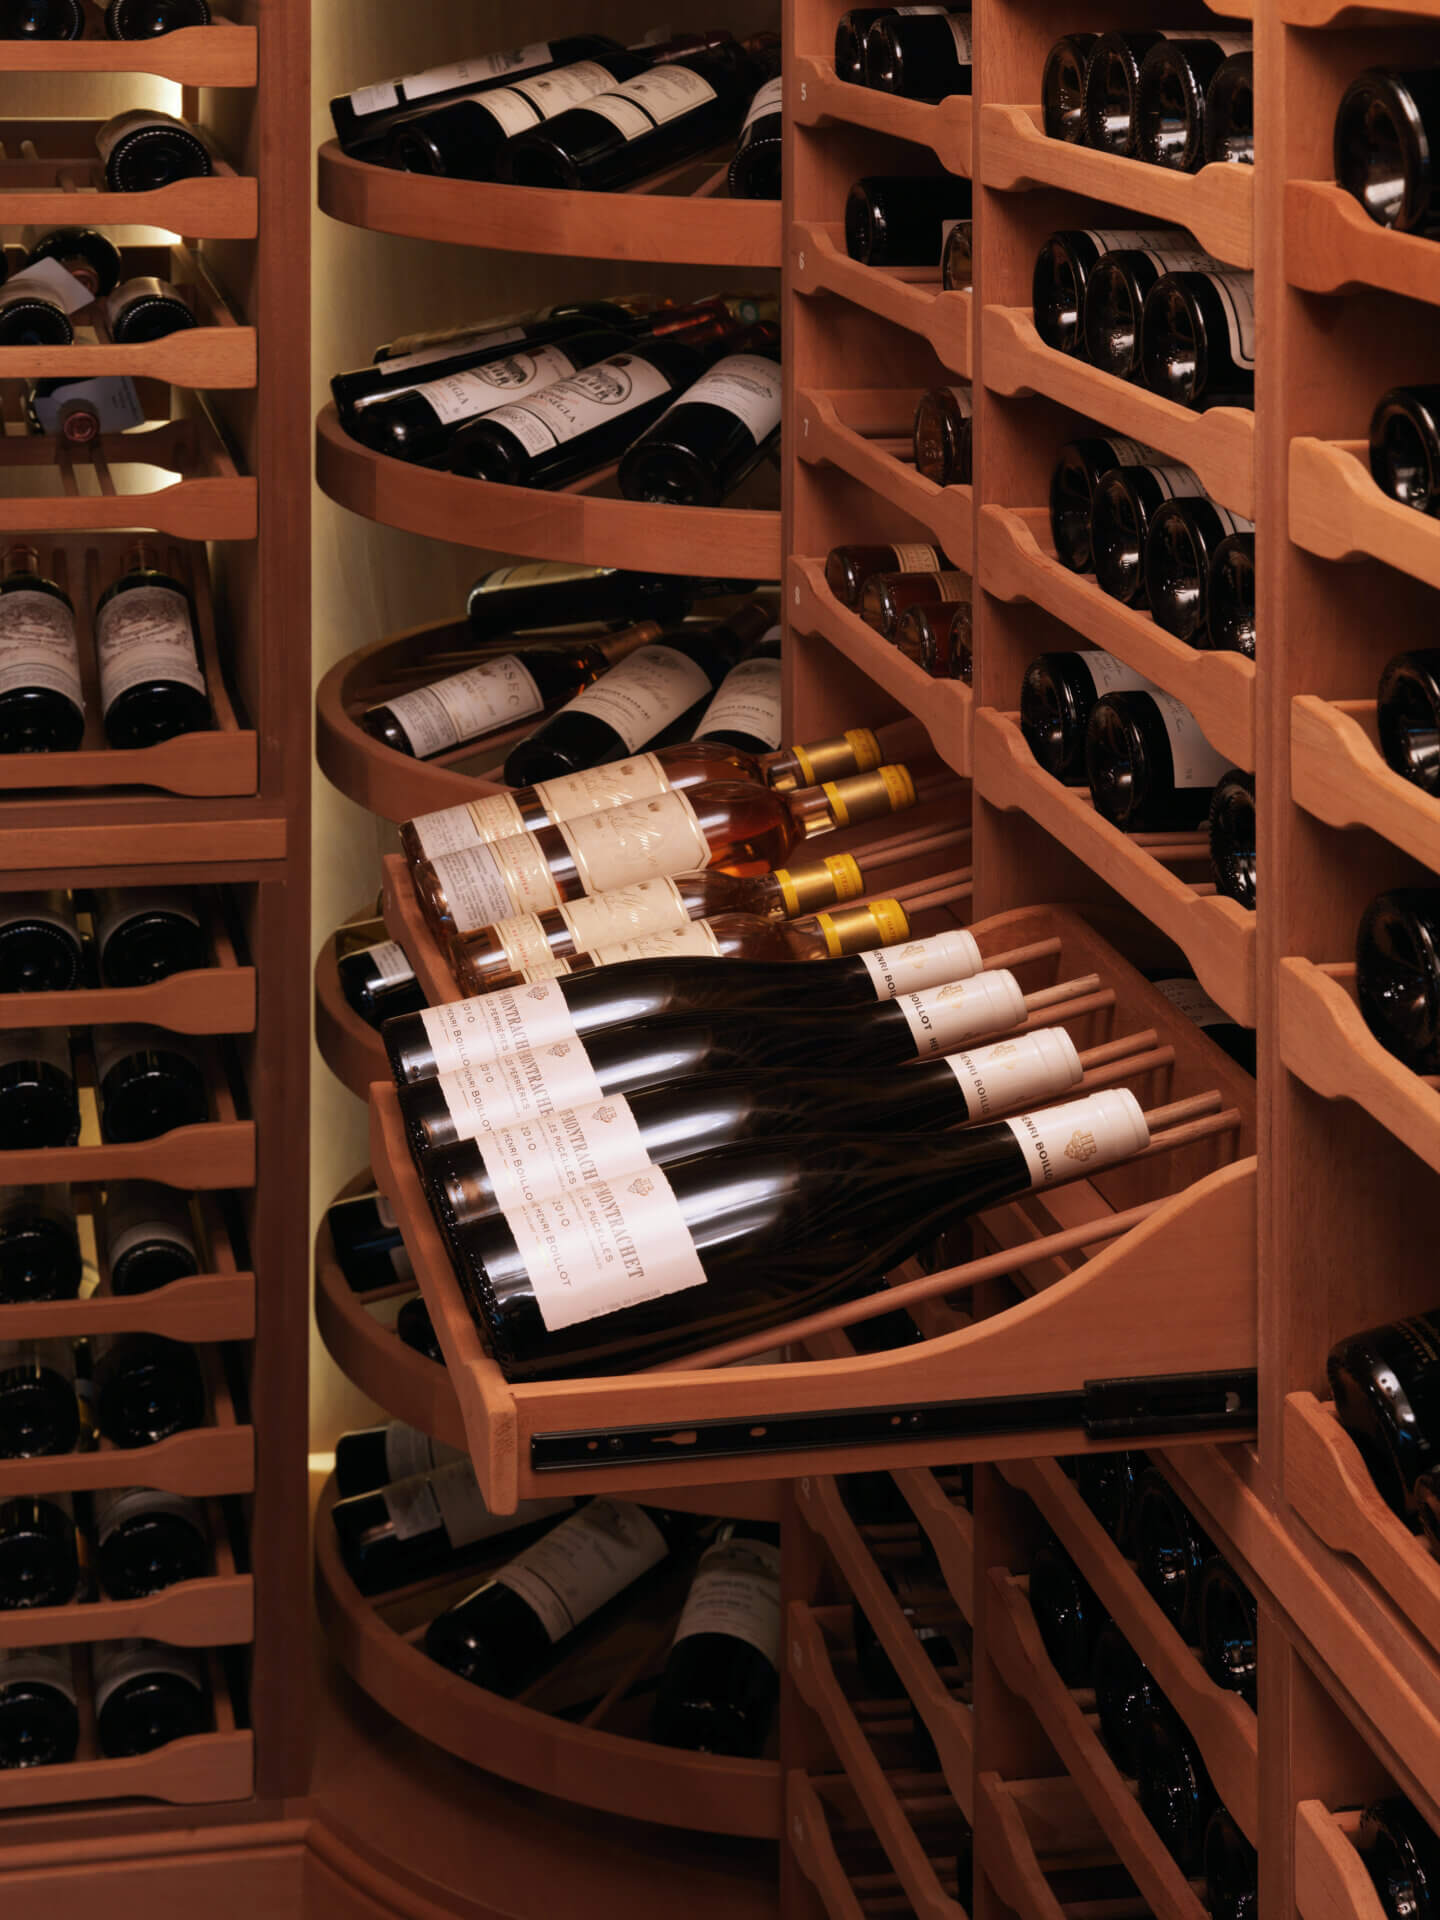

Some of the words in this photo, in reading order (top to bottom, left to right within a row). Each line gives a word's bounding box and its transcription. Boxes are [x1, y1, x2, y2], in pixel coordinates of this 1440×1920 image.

[800, 82, 807, 102] 5
[453, 1029, 472, 1067] BOILLO
[552, 1200, 571, 1228] 2010
[536, 1207, 551, 1233] HENRI
[546, 1235, 573, 1289] BOILLOT
